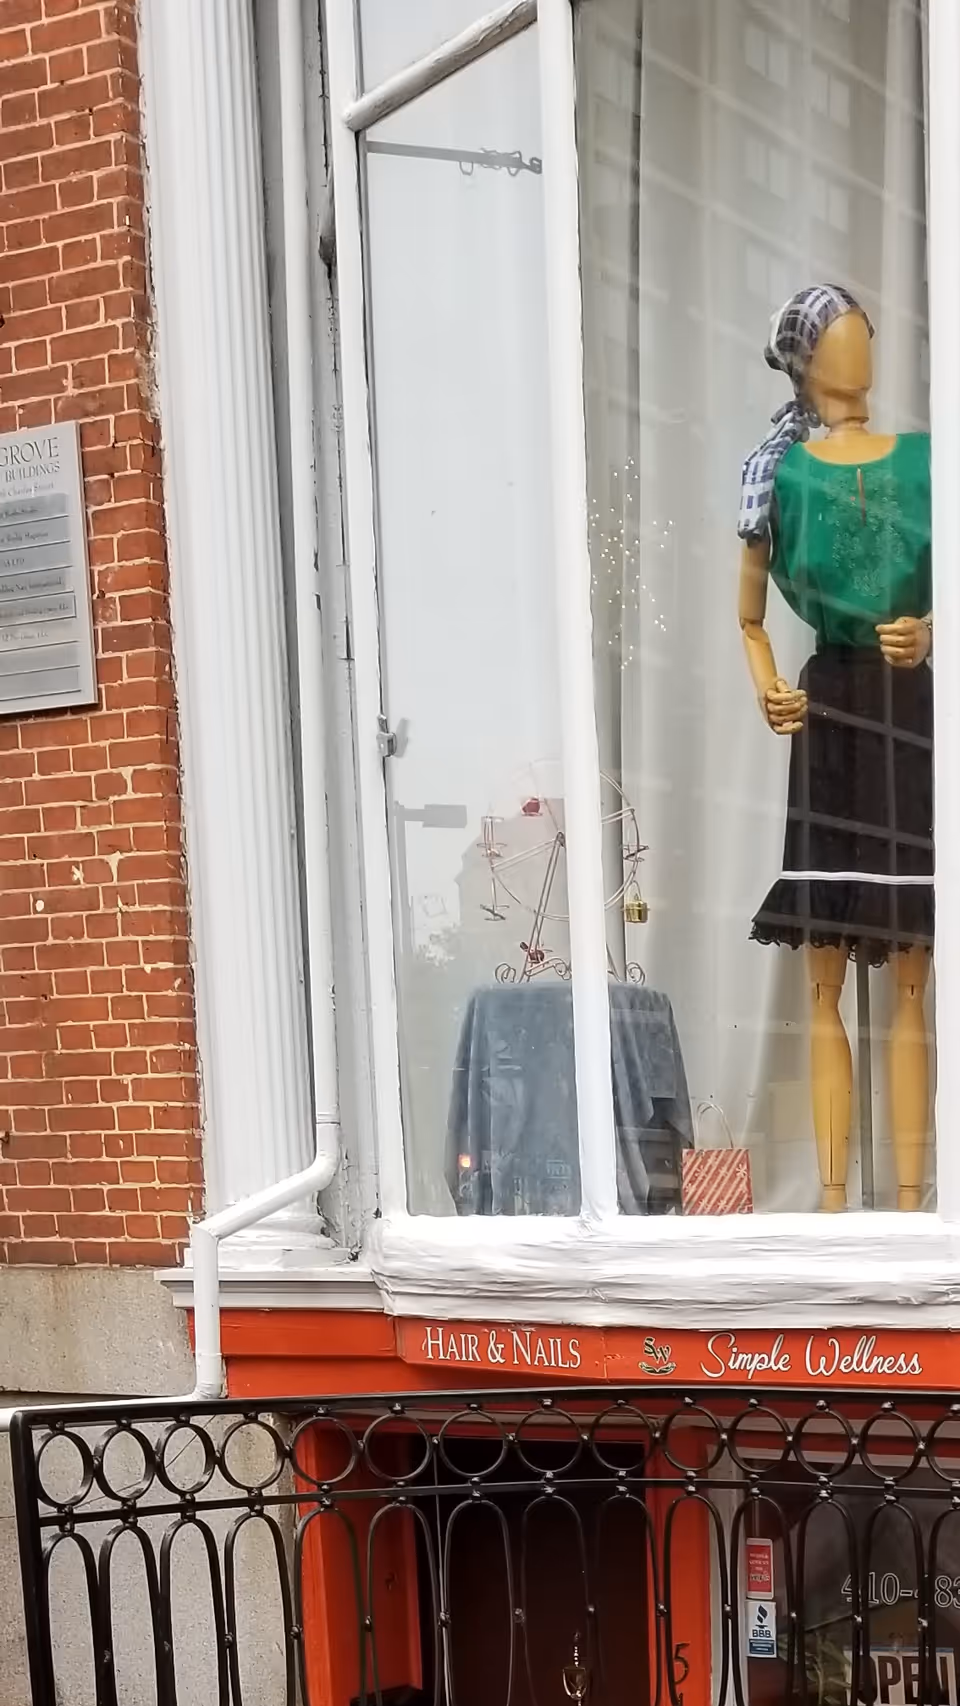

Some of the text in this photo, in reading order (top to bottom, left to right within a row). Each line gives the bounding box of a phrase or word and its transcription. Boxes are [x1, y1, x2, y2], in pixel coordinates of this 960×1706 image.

[5, 460, 61, 483] BUILDINGS
[425, 1326, 581, 1369] HAIR & NAILS
[699, 1328, 923, 1380] Simple Wellness
[752, 1629, 772, 1638] BBB
